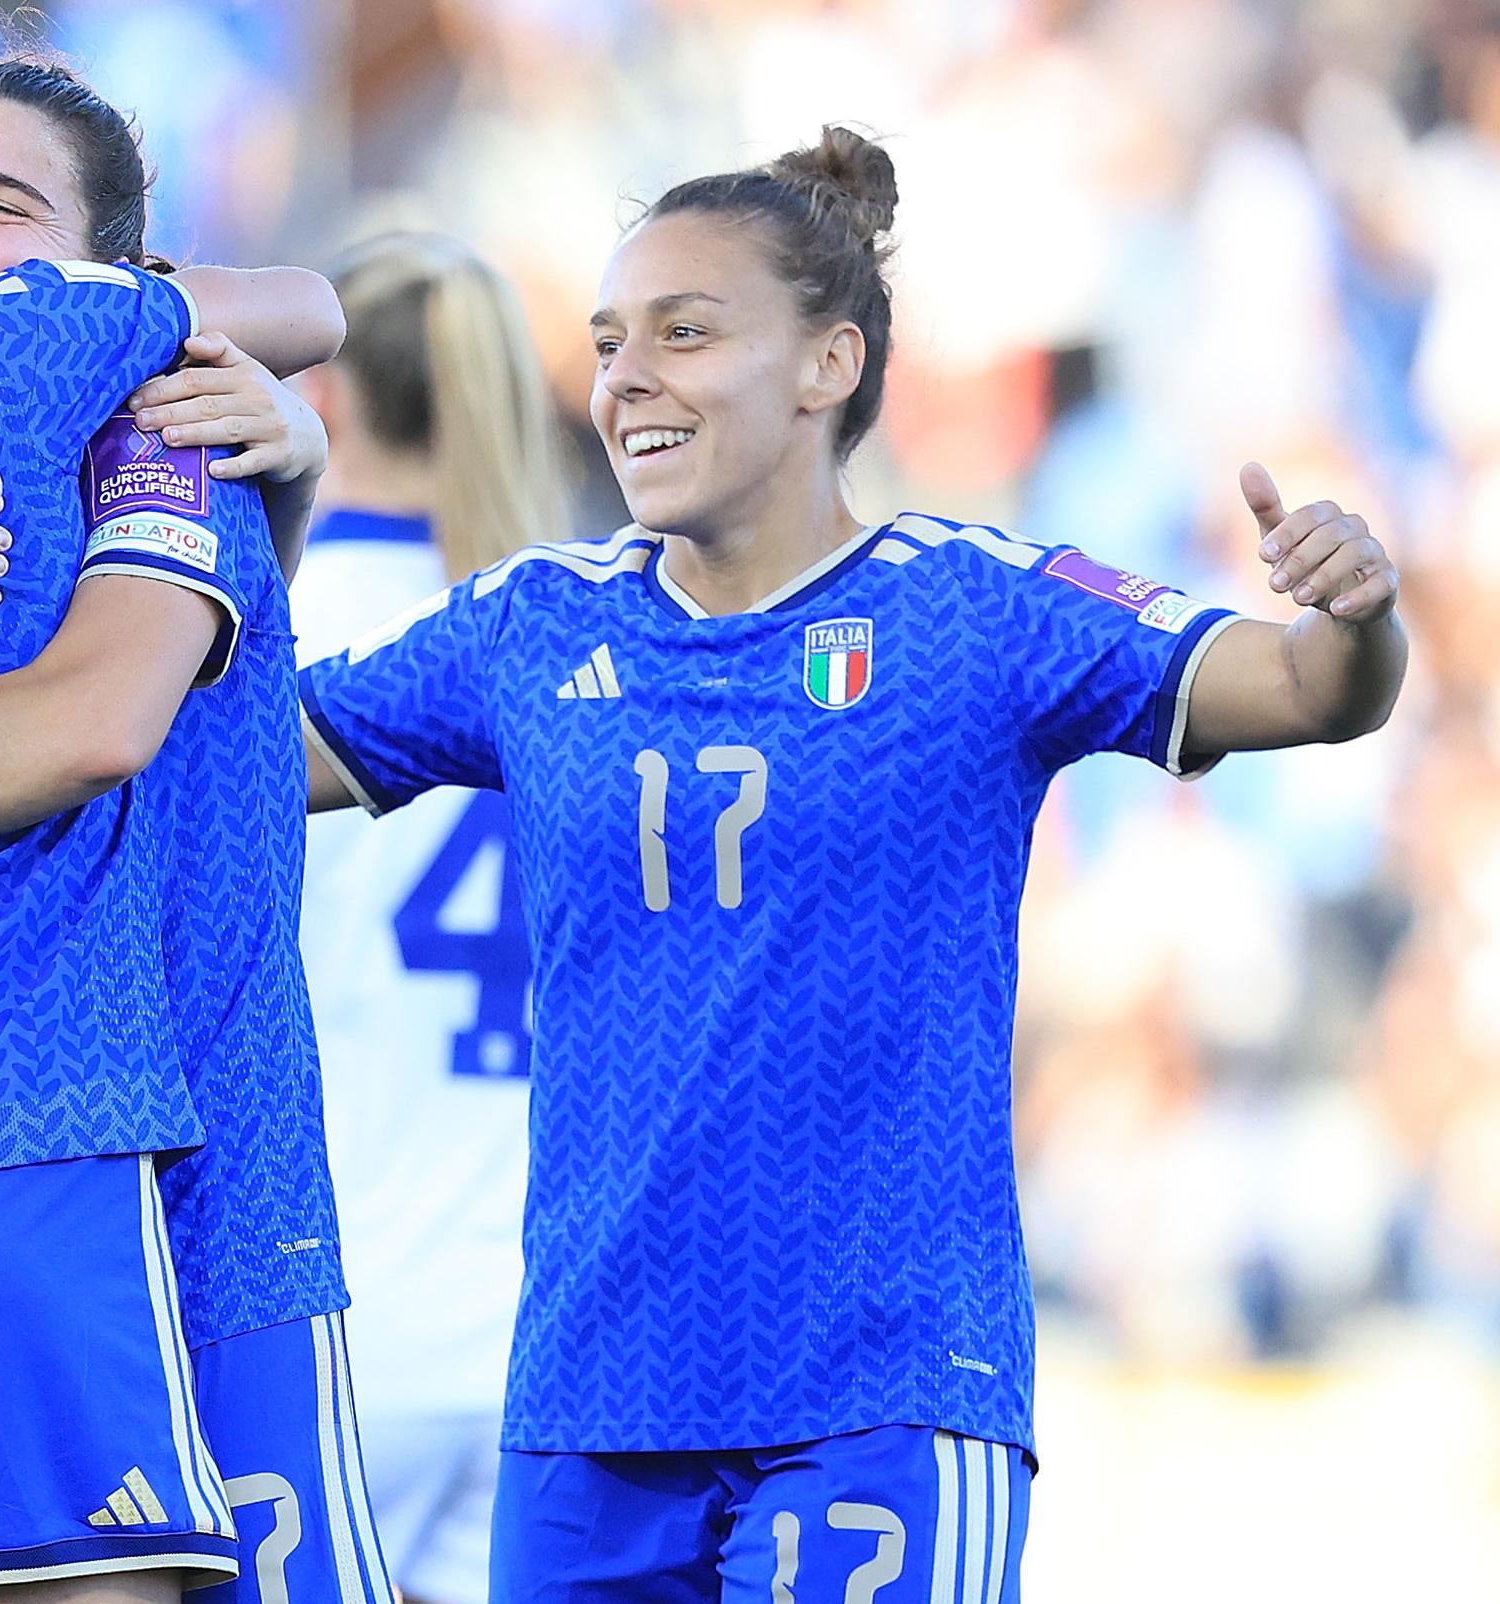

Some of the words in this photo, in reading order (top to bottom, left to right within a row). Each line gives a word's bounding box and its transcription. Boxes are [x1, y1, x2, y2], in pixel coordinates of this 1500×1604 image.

[117, 461, 176, 473] women's
[100, 482, 196, 505] QUALIFIERS
[101, 471, 194, 493] EUROPEAN
[86, 523, 212, 558] OUNDATION
[810, 625, 867, 648] ITALIA
[633, 745, 768, 913] 17
[393, 785, 534, 1078] 4
[772, 1501, 907, 1604] 17
